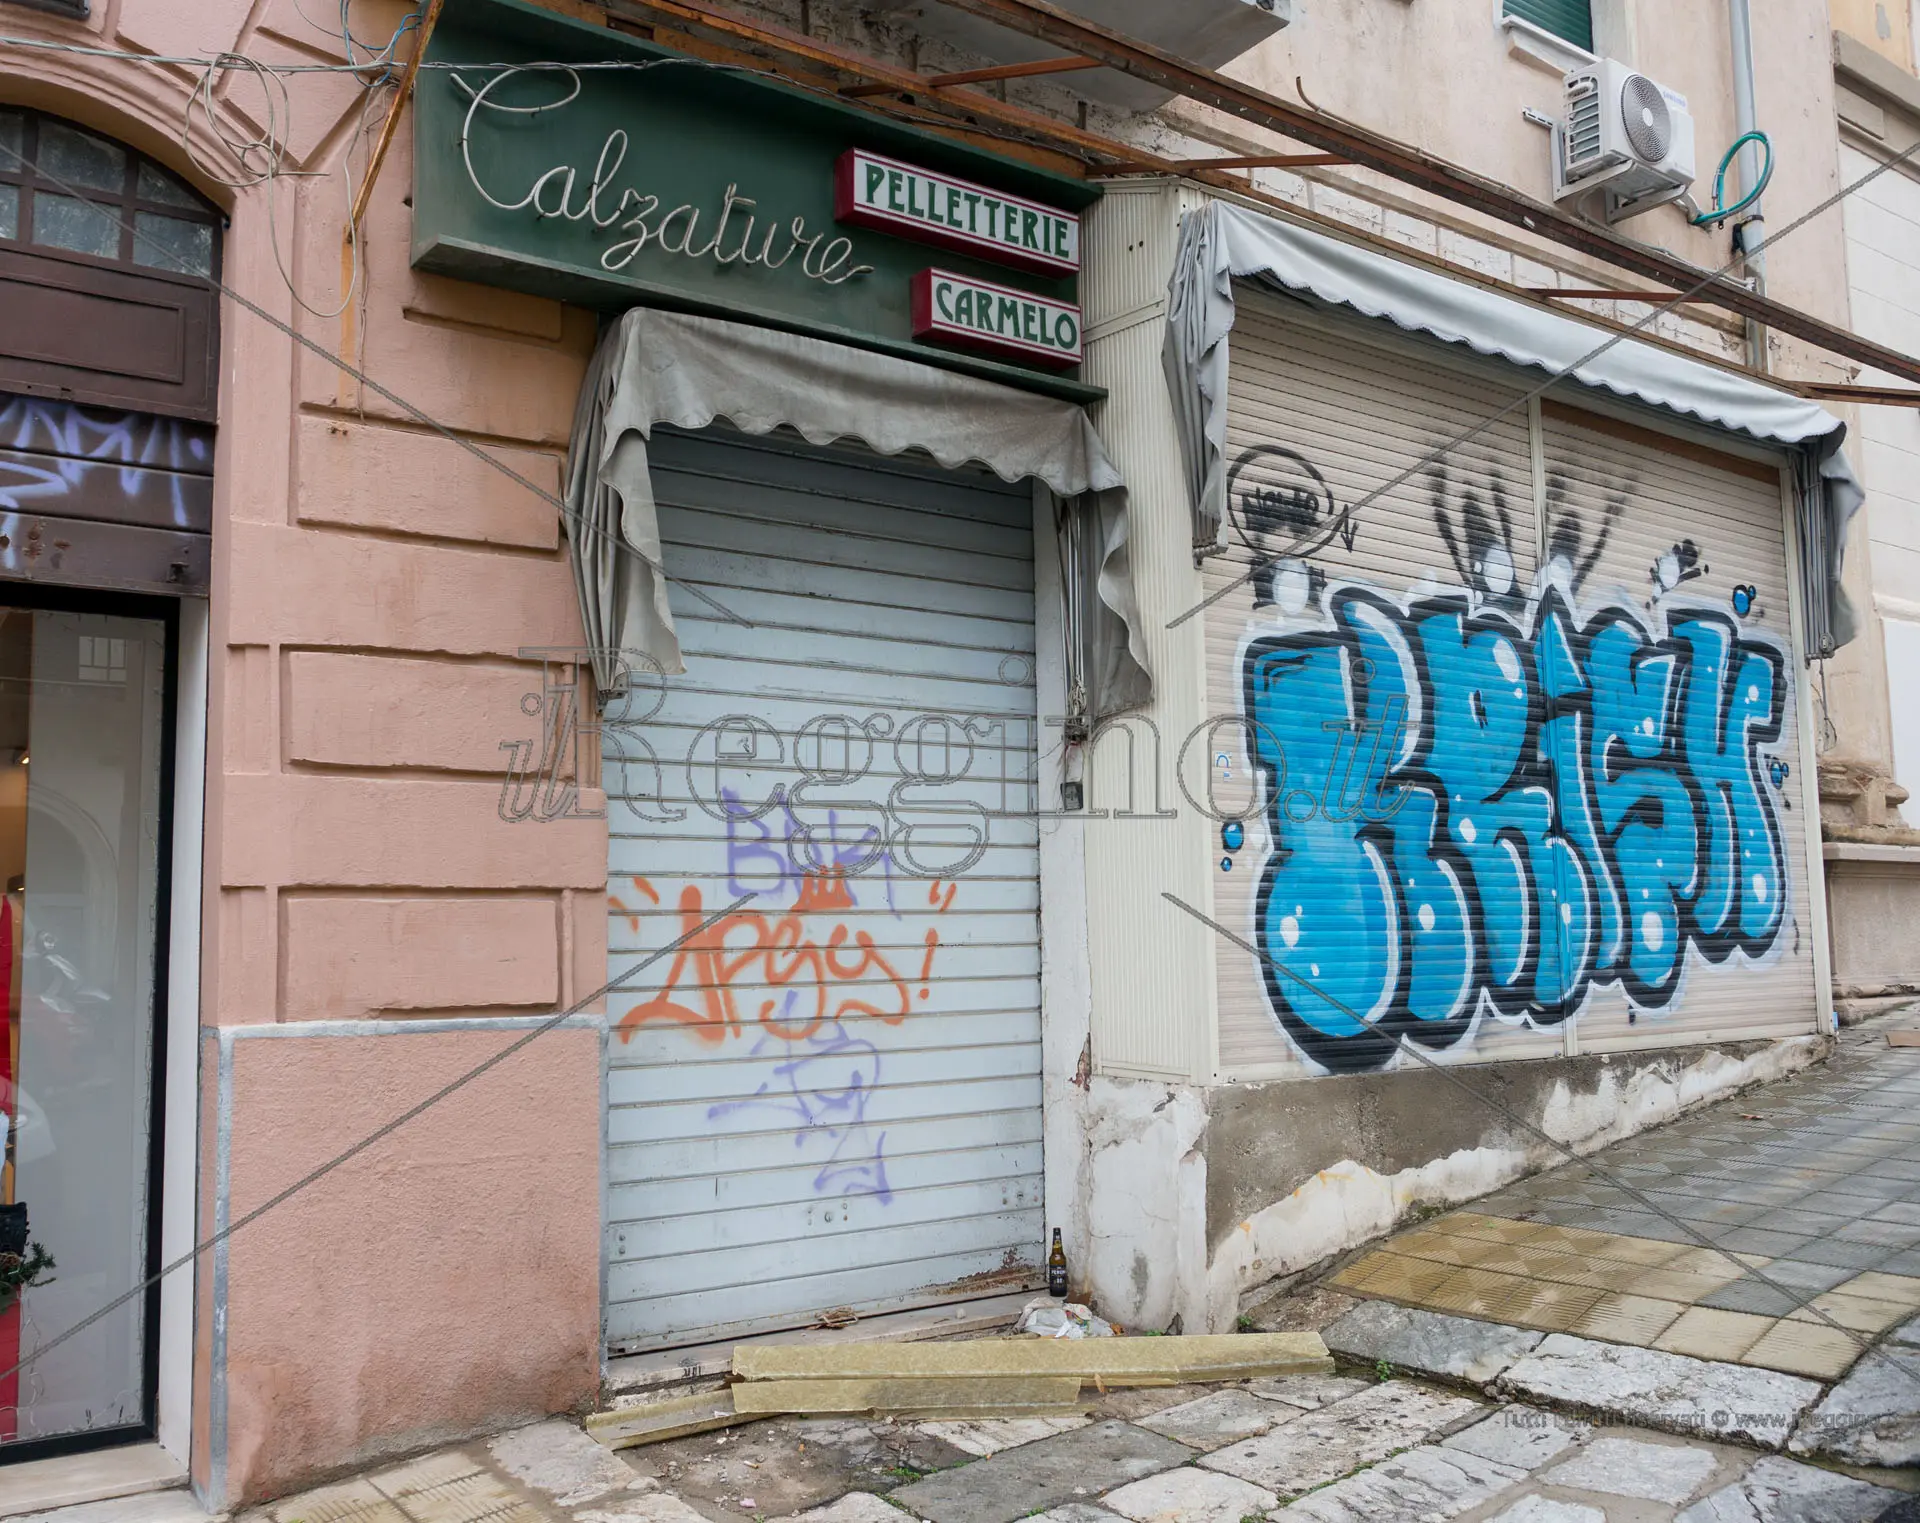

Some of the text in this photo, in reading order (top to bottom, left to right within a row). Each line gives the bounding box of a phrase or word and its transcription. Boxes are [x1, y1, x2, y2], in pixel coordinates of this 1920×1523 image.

[450, 62, 875, 284] Calzature
[865, 163, 1070, 259] PELLETTERIE
[935, 282, 1078, 350] CARMELO
